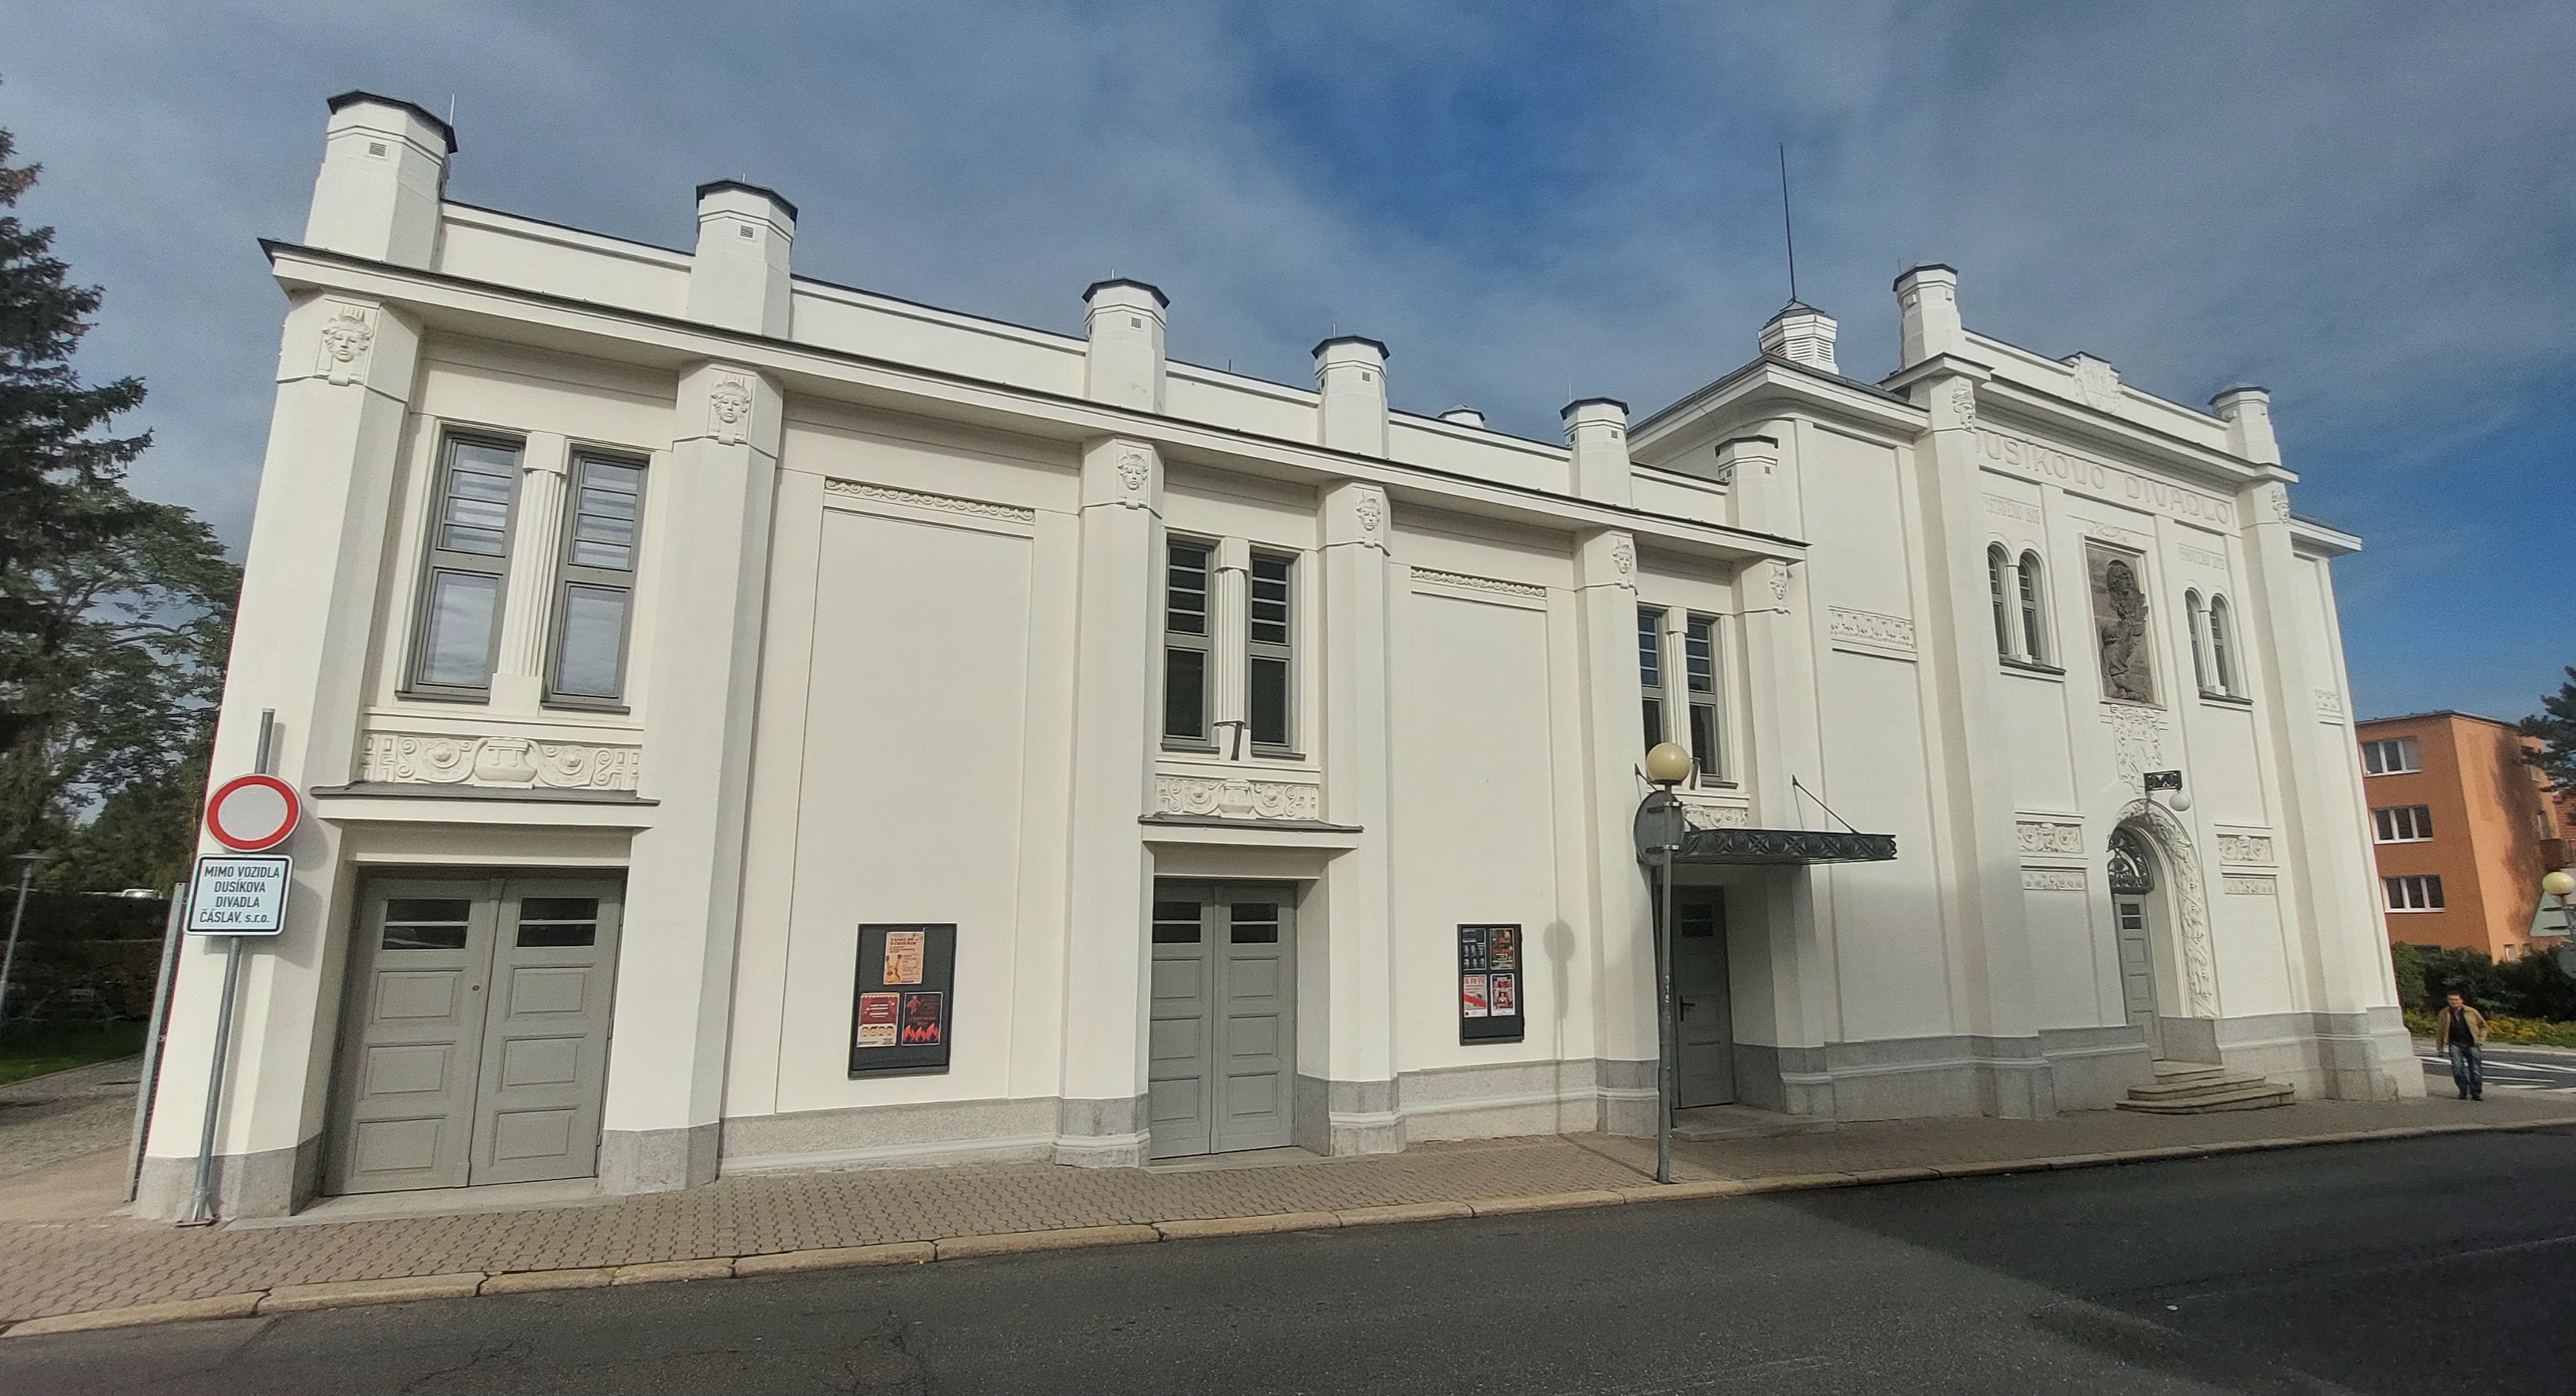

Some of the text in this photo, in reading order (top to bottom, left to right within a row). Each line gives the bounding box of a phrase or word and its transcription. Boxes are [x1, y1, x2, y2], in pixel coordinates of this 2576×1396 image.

[2125, 475, 2228, 524] DIVADLO
[204, 866, 279, 878] MIMO VOZIDLA
[214, 879, 265, 893] DUSÍKOVA
[216, 897, 259, 907] DIVADLA
[199, 908, 269, 923] ČÁSLAV, s.r.o.
